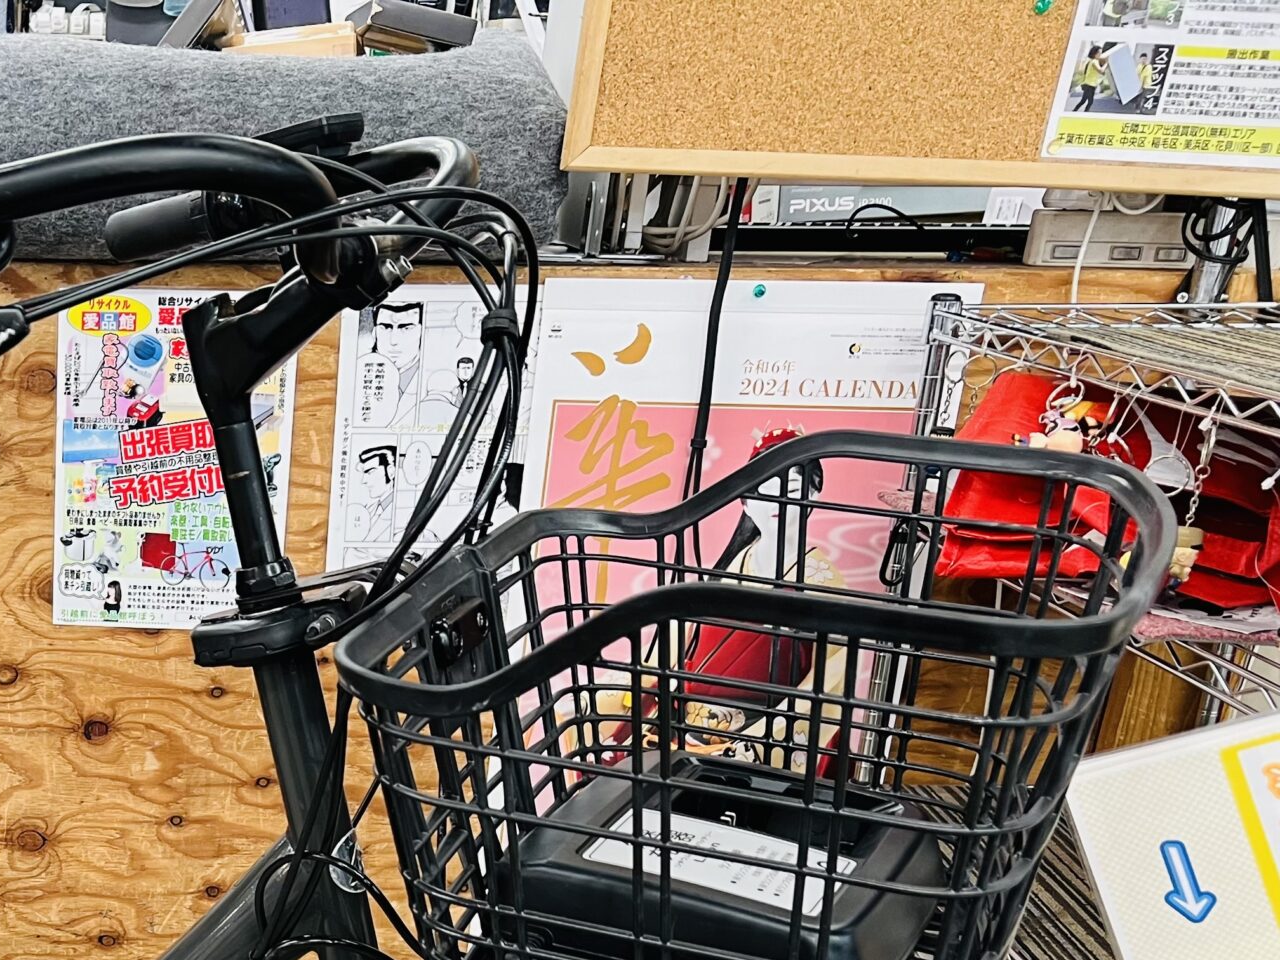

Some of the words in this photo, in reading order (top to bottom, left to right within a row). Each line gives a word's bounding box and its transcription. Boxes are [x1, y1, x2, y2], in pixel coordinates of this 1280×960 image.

[789, 195, 855, 214] PIXUS
[88, 299, 132, 310] リサイクル
[158, 296, 204, 307] 総合リサイ
[82, 312, 137, 331] 愛品館
[742, 359, 797, 375] 令和6年
[738, 378, 790, 398] 2024
[798, 377, 919, 399] CALENDA
